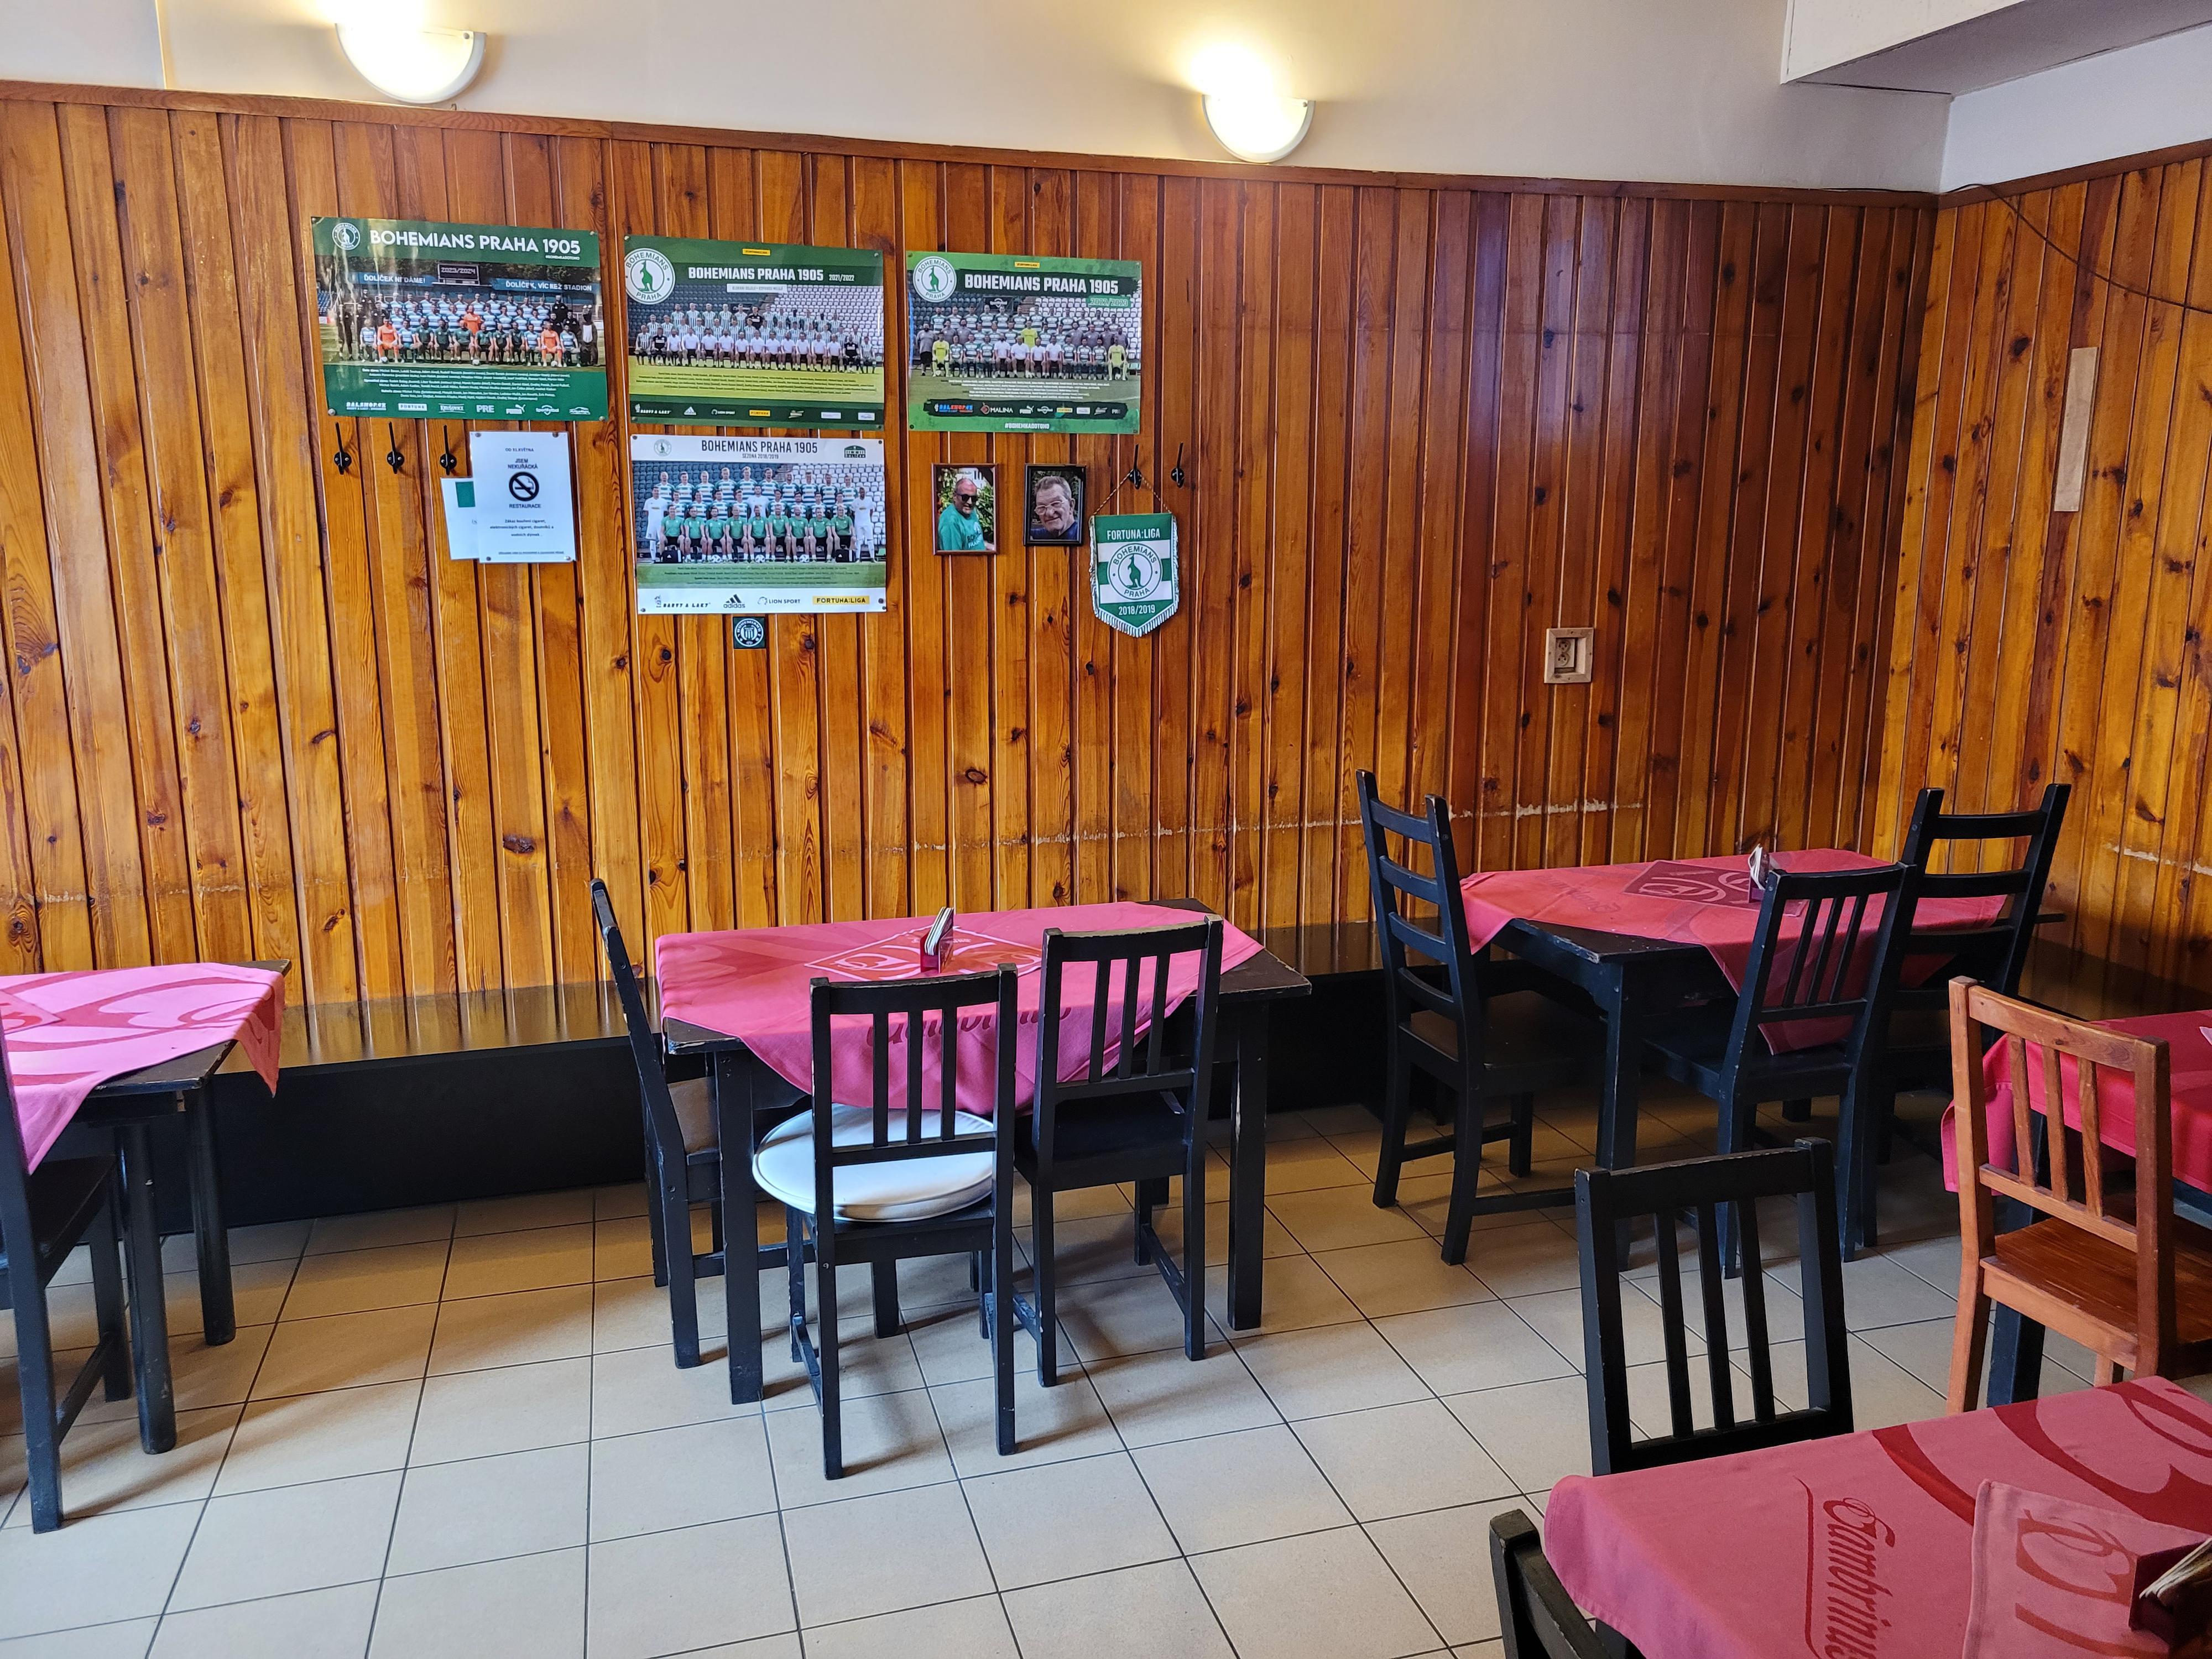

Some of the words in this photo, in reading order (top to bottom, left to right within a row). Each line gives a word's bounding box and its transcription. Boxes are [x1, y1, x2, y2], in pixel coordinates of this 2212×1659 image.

[370, 229, 475, 249] BOHEMIANS
[479, 235, 539, 253] PRAHA
[542, 239, 581, 254] 1905
[625, 252, 669, 270] BOHEMIANS
[918, 259, 952, 274] BOHEMIANS
[688, 267, 755, 280] BOHEMIANS
[758, 268, 796, 281] PRAHA
[797, 269, 824, 281] 1905
[828, 274, 855, 282] 2021/2022
[964, 274, 1041, 291] BOHEMIANS
[1044, 278, 1087, 293] PRAHA
[1089, 279, 1119, 294] 1905
[636, 291, 662, 301] PRAHA
[1090, 298, 1129, 307] 2022/2023
[476, 404, 495, 413] PRE
[702, 440, 758, 452] BOHEMIANS
[761, 441, 792, 453] PRAHA
[794, 442, 818, 453] 1905
[1107, 528, 1161, 540] FORTUNA:LIGA
[1113, 545, 1157, 566] BOHEMIANS
[1124, 587, 1150, 598] PRAHA
[1118, 603, 1156, 616] 2018/2019
